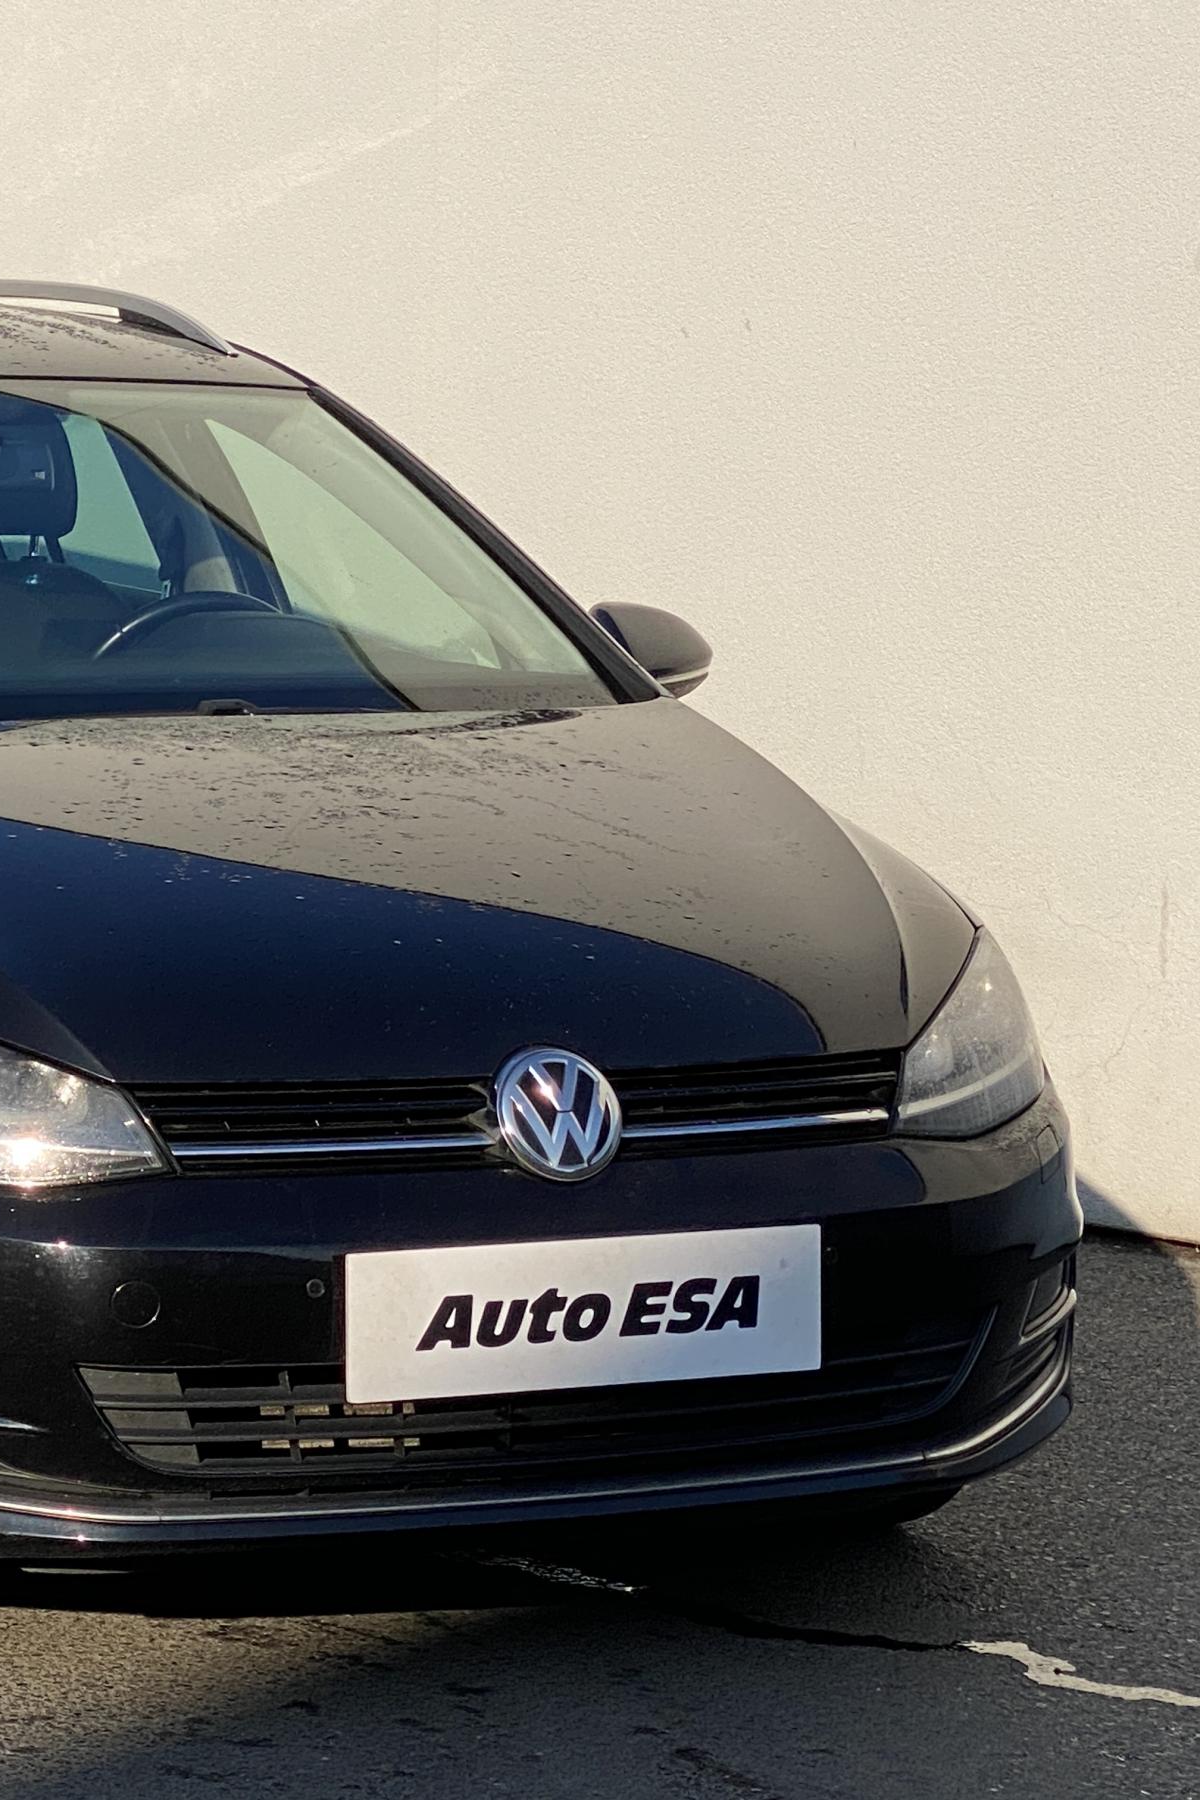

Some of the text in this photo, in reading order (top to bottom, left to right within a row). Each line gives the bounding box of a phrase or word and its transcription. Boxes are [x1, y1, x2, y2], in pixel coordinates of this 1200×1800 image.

[501, 1051, 615, 1176] VW
[415, 1274, 761, 1352] Auto ESA
